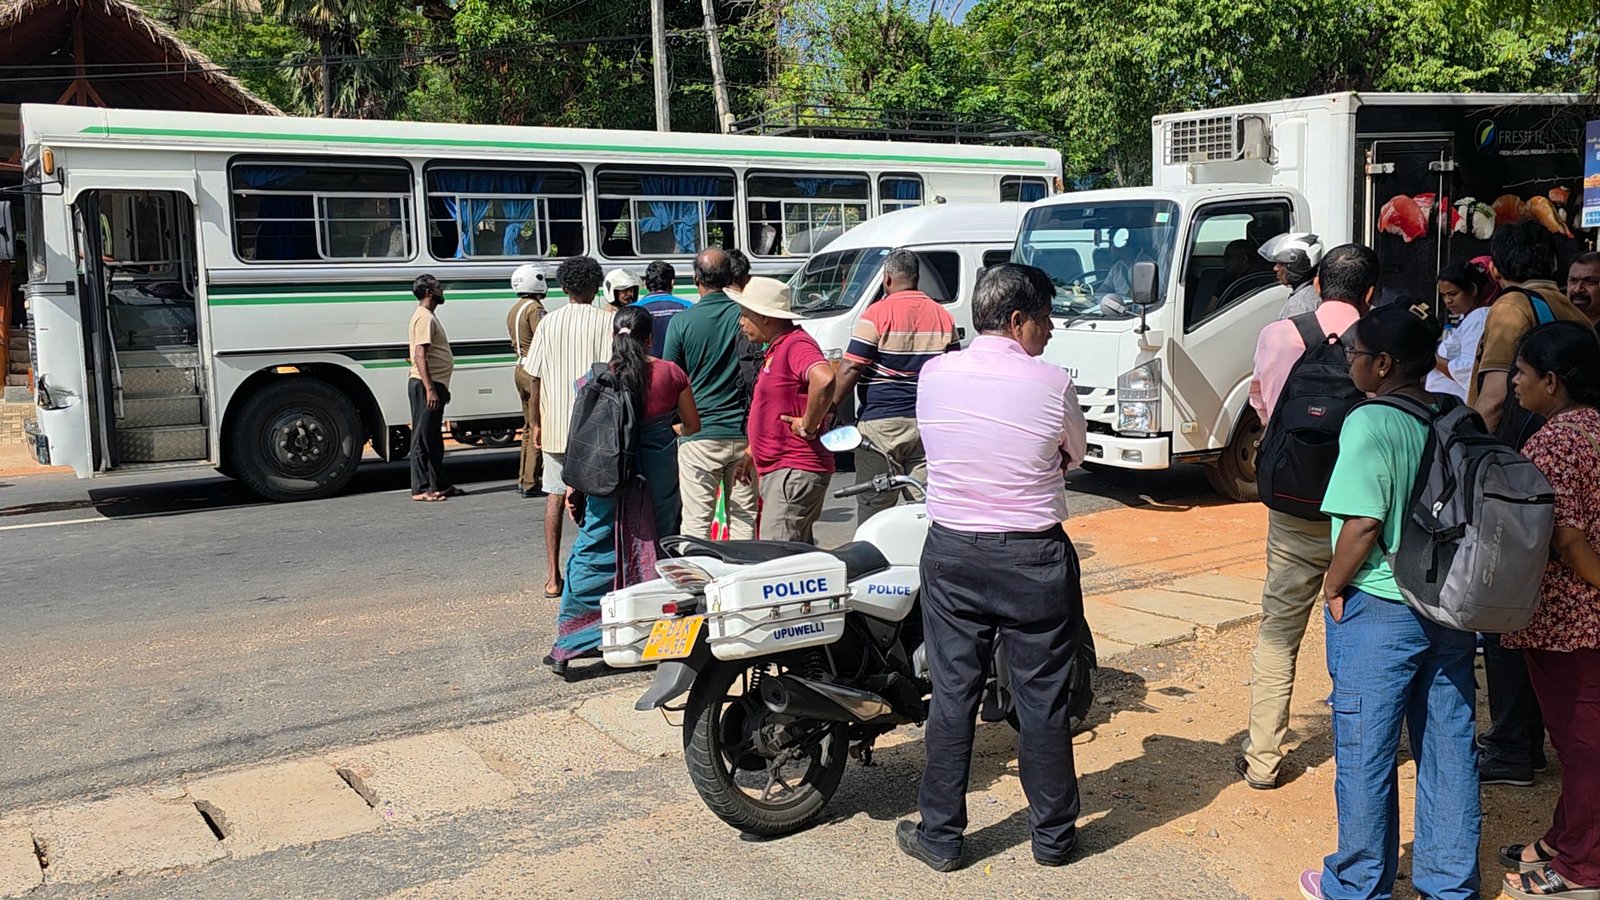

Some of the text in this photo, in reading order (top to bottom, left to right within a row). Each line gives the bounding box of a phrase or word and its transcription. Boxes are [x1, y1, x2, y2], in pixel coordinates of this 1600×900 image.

[1498, 130, 1532, 144] FRESH
[762, 577, 828, 599] POLICE
[867, 583, 911, 596] POLICE
[773, 622, 825, 640] UPUWELLI
